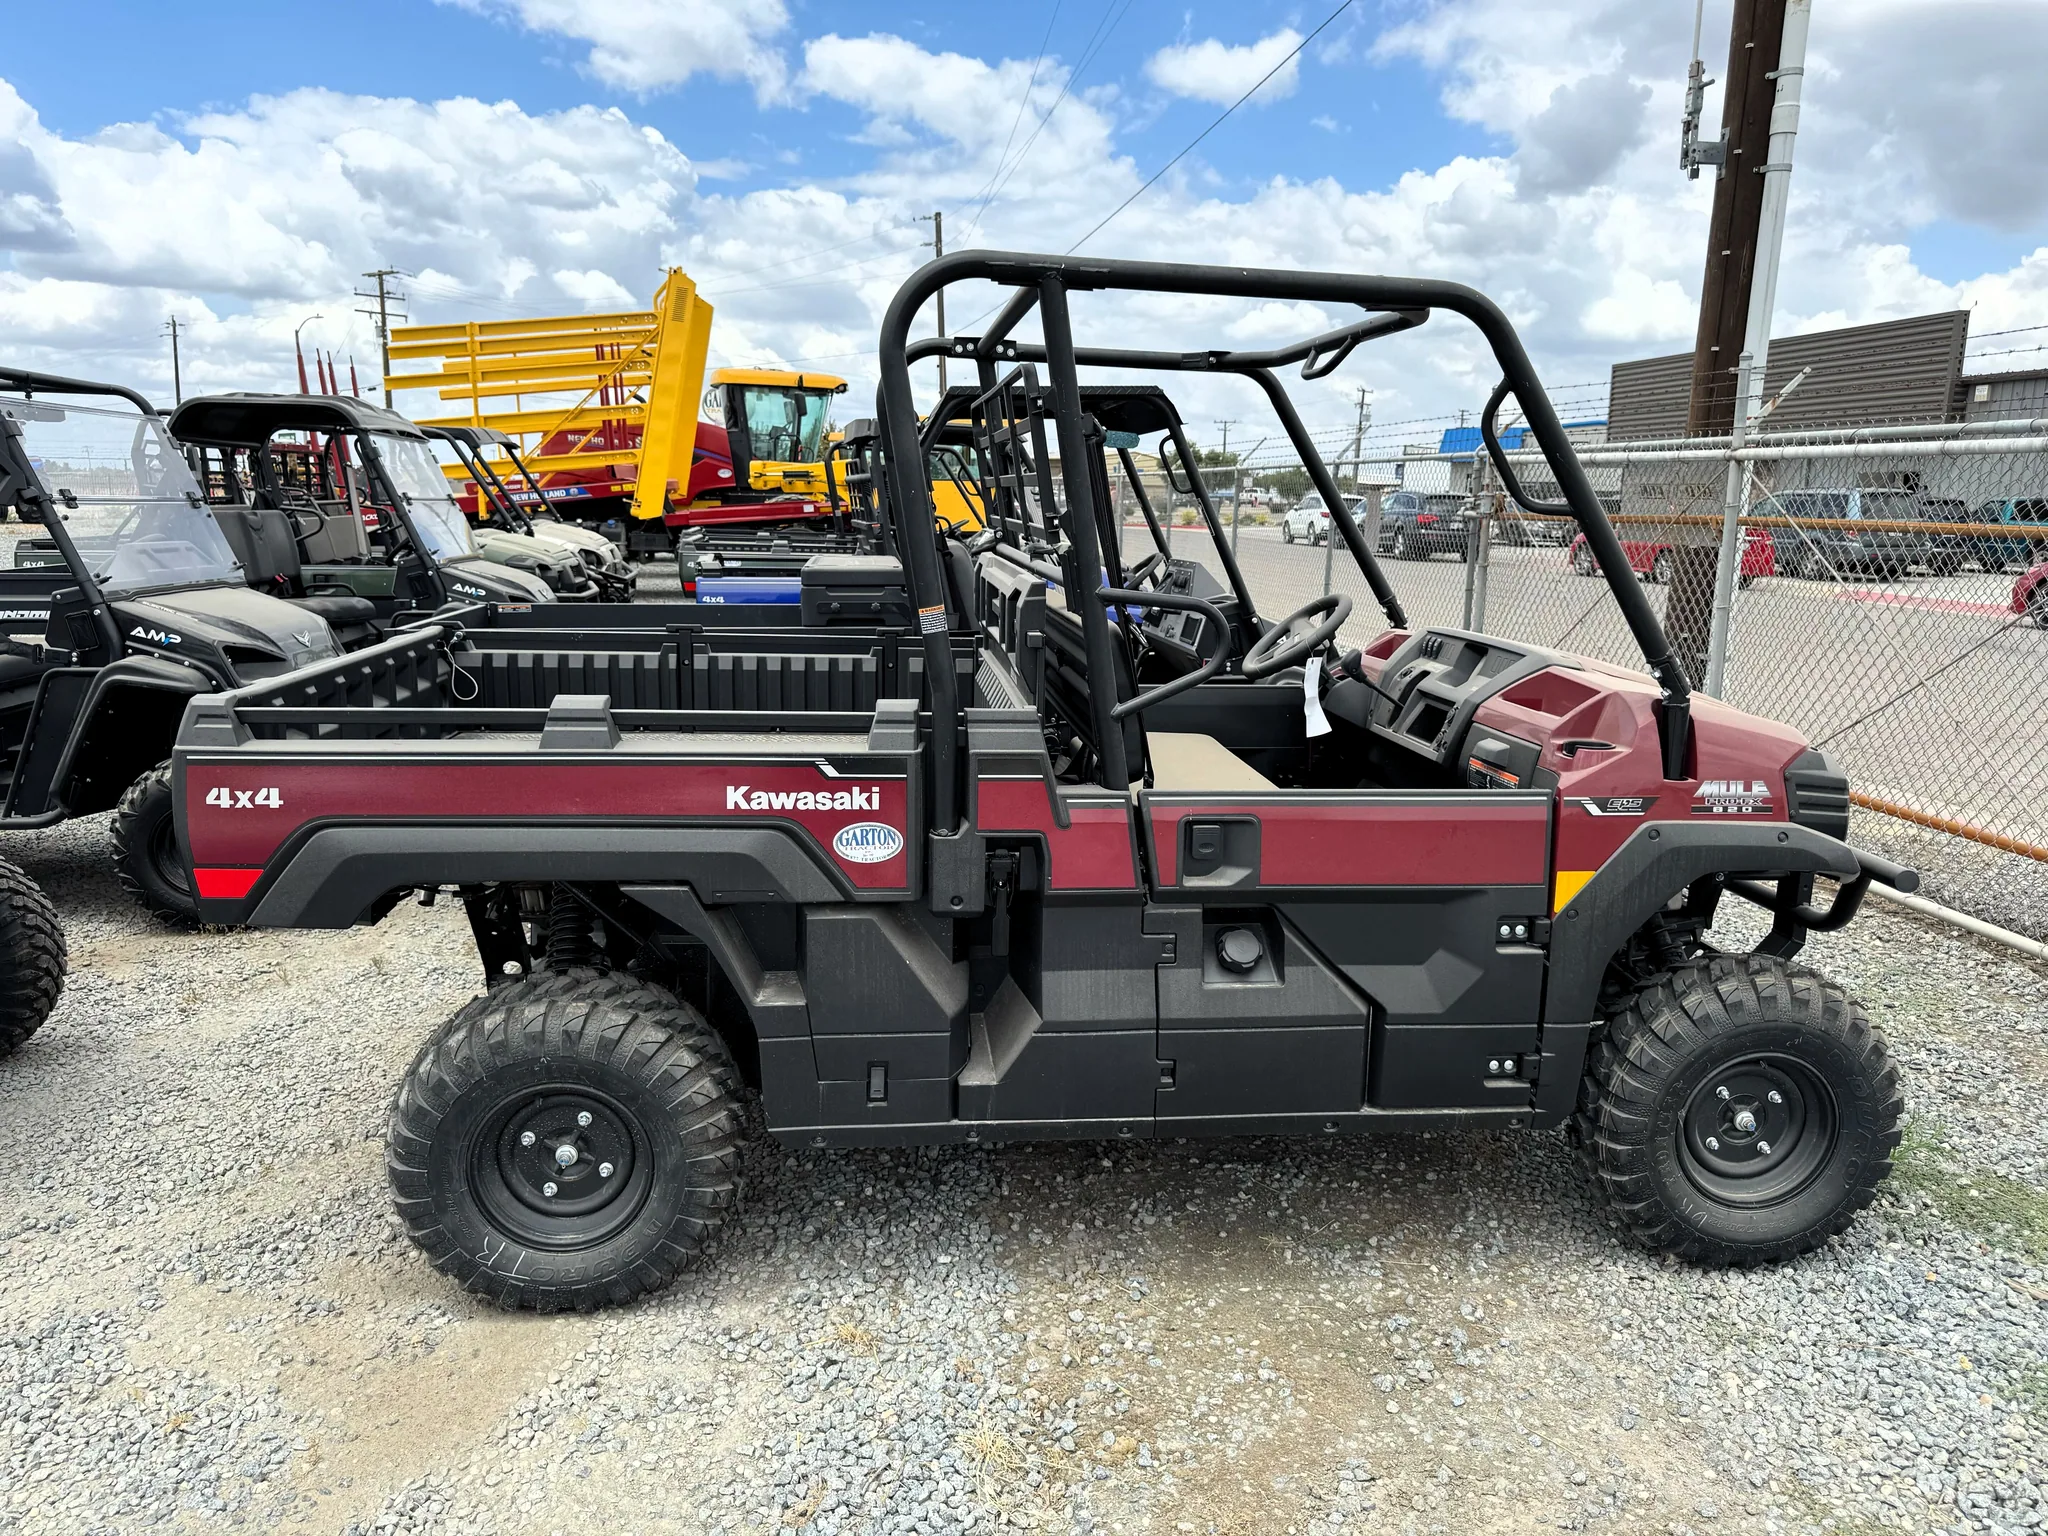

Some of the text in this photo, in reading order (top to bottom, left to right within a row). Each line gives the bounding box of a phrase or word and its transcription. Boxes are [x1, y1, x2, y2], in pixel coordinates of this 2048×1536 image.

[511, 489, 566, 502] NEW HOLAND
[452, 583, 486, 597] AMP
[702, 595, 725, 604] 4x4
[130, 626, 182, 647] AMP
[205, 787, 284, 809] 4x4
[726, 785, 880, 811] Kawasaki
[1693, 780, 1773, 798] MULE
[838, 827, 897, 847] GARTON
[529, 1237, 643, 1282] DURO
